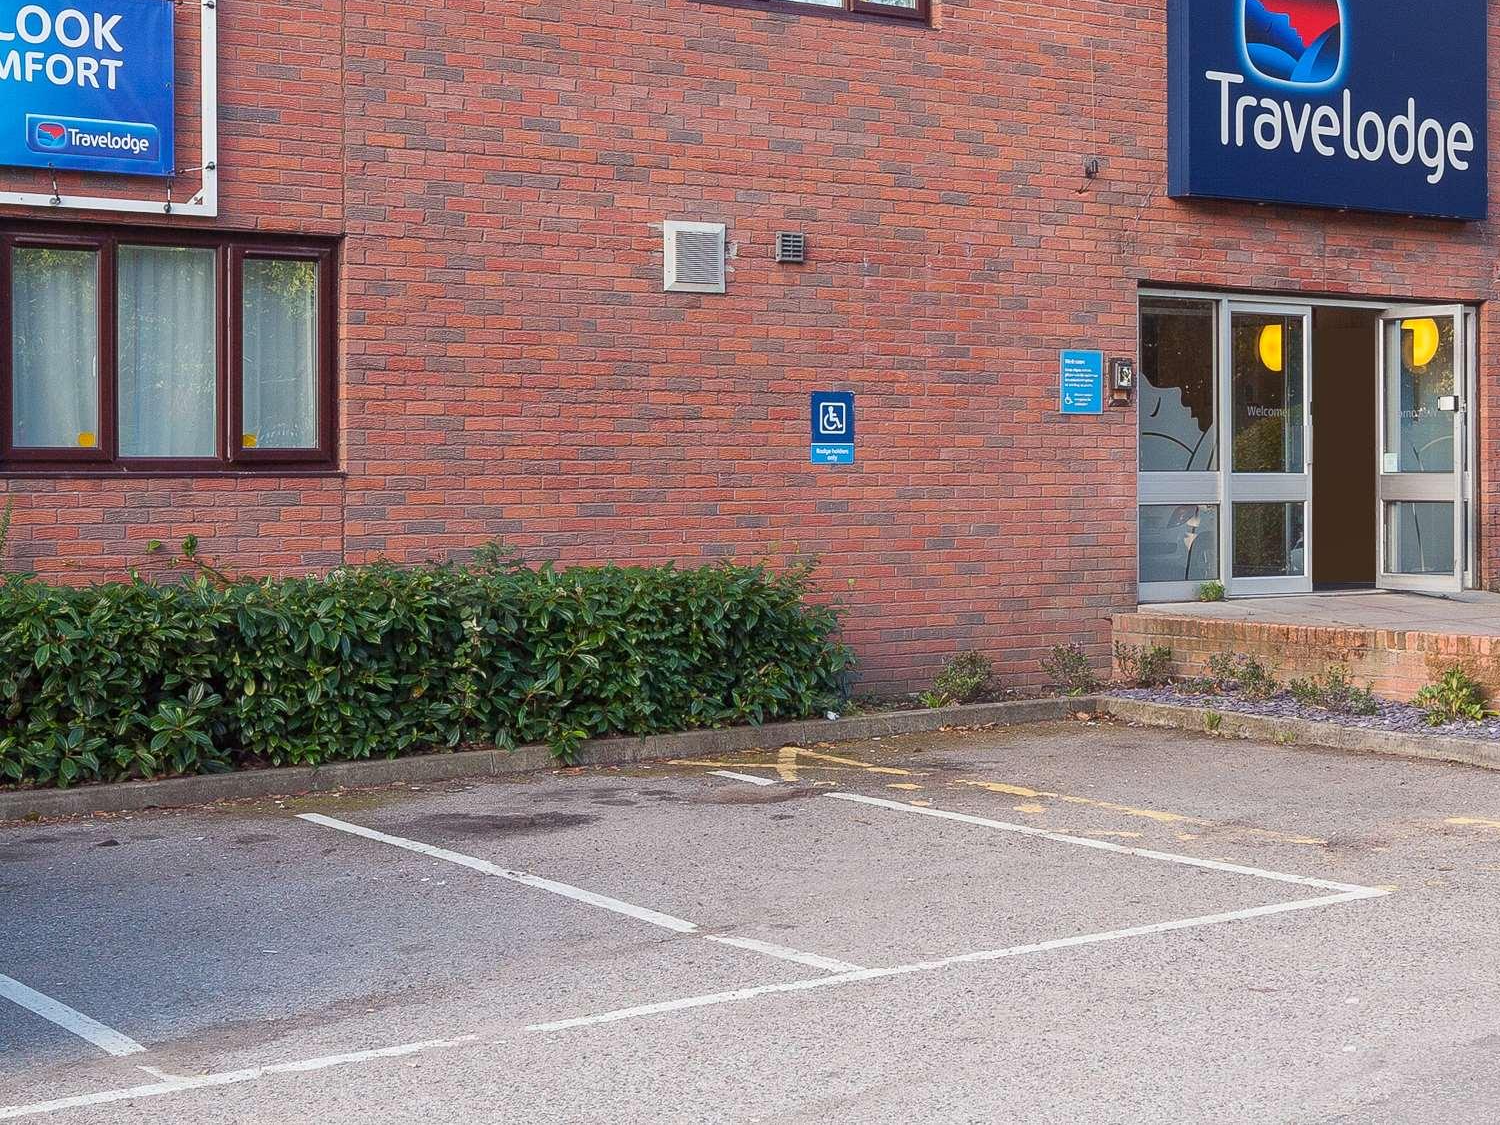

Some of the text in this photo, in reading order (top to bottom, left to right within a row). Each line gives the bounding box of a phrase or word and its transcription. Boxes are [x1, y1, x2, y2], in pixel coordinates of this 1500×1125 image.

[1205, 70, 1474, 184] Travelodge
[67, 128, 149, 154] Travelodge
[1247, 405, 1288, 417] Welcome
[827, 454, 838, 462] only
